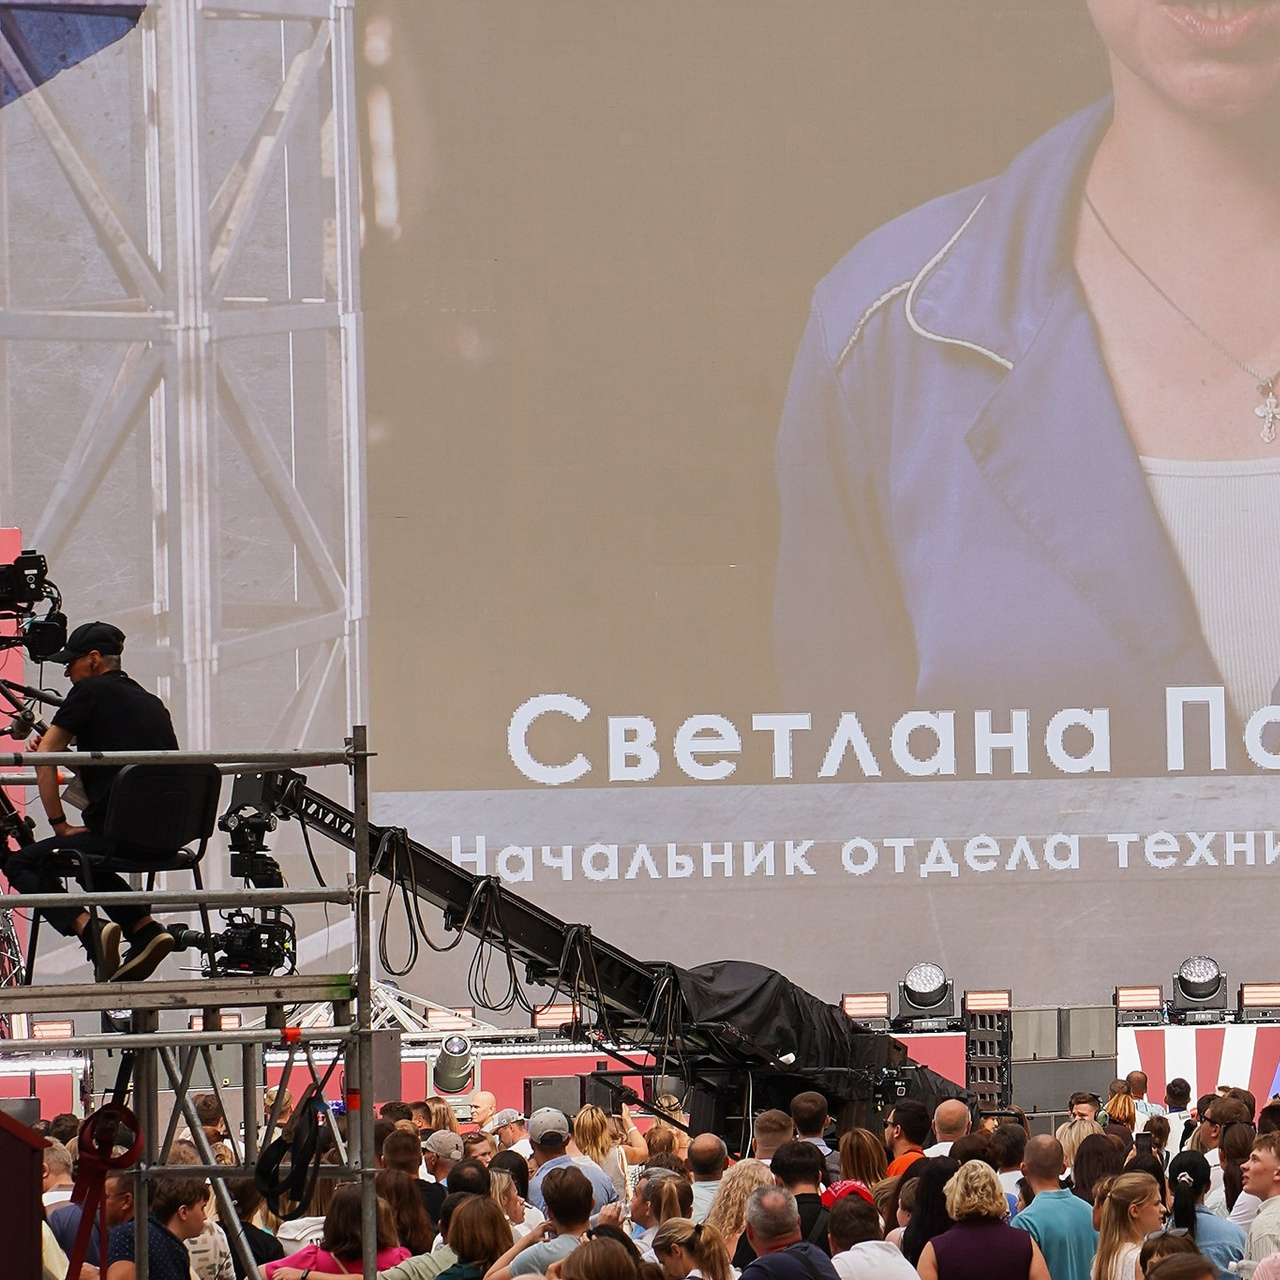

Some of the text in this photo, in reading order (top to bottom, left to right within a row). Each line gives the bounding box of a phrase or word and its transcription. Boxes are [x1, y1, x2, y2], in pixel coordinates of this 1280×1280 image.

[508, 693, 1111, 785] Светлана
[451, 835, 817, 883] Начальник
[841, 833, 1081, 878] отдела
